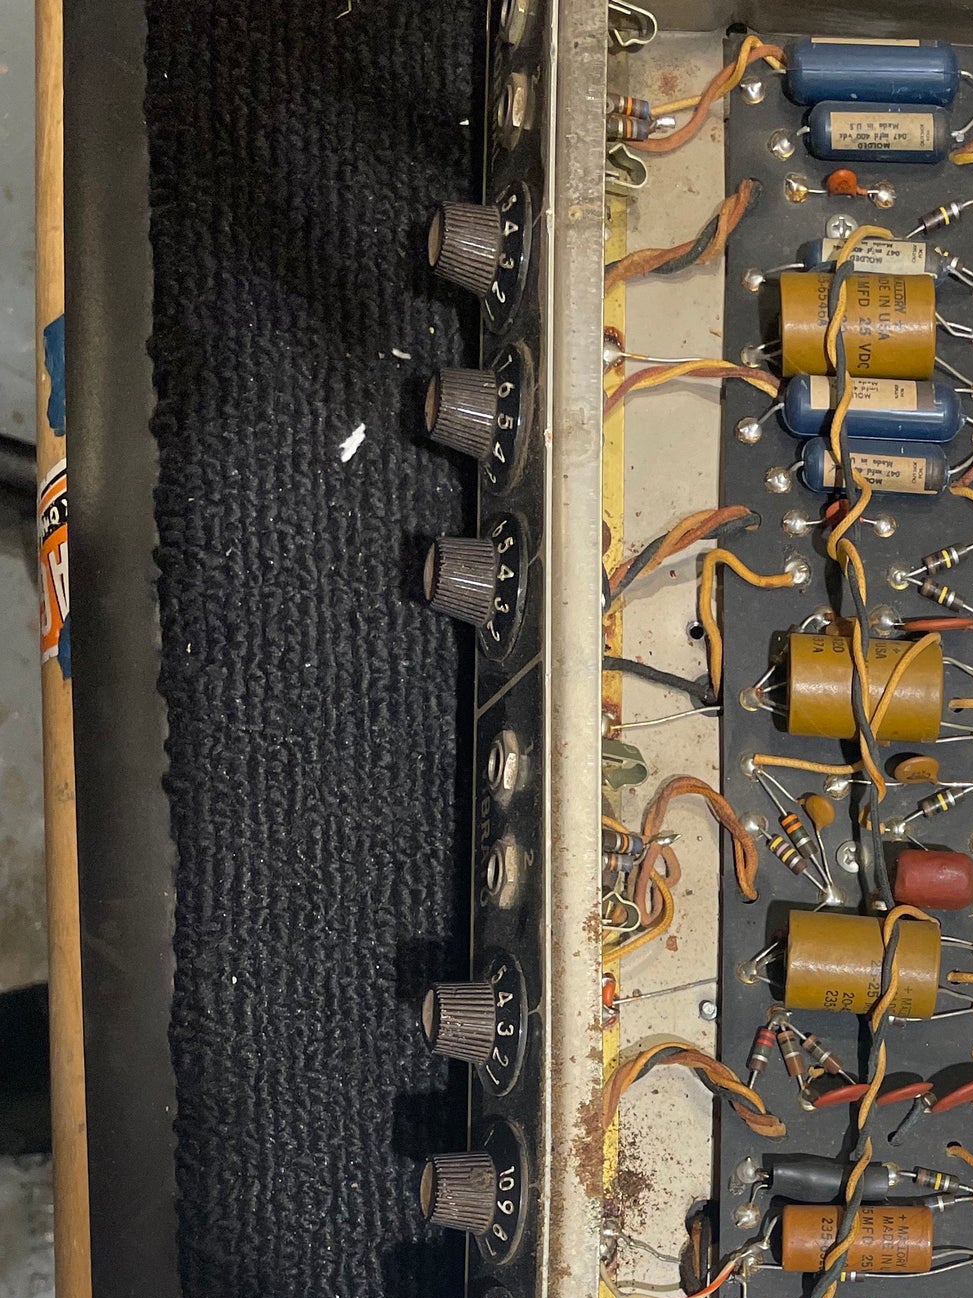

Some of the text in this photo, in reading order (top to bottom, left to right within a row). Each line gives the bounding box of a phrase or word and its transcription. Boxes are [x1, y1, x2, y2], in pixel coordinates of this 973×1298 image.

[504, 221, 518, 236] 4
[500, 253, 515, 269] 3
[492, 281, 506, 303] 2
[857, 281, 871, 307] MFD
[878, 296, 891, 307] IN
[857, 344, 872, 369] VDC
[498, 381, 515, 399] 6
[498, 413, 513, 430] 5
[498, 536, 514, 554] 5
[498, 564, 515, 581] 4
[494, 597, 509, 614] 3
[492, 965, 508, 985] 5
[497, 991, 513, 1007] 4
[497, 1021, 514, 1036] 3
[492, 1047, 510, 1067] 2
[498, 1166, 515, 1192] 10
[497, 1200, 514, 1215] 9
[492, 1223, 508, 1241] 8
[882, 1215, 894, 1250] MADE
